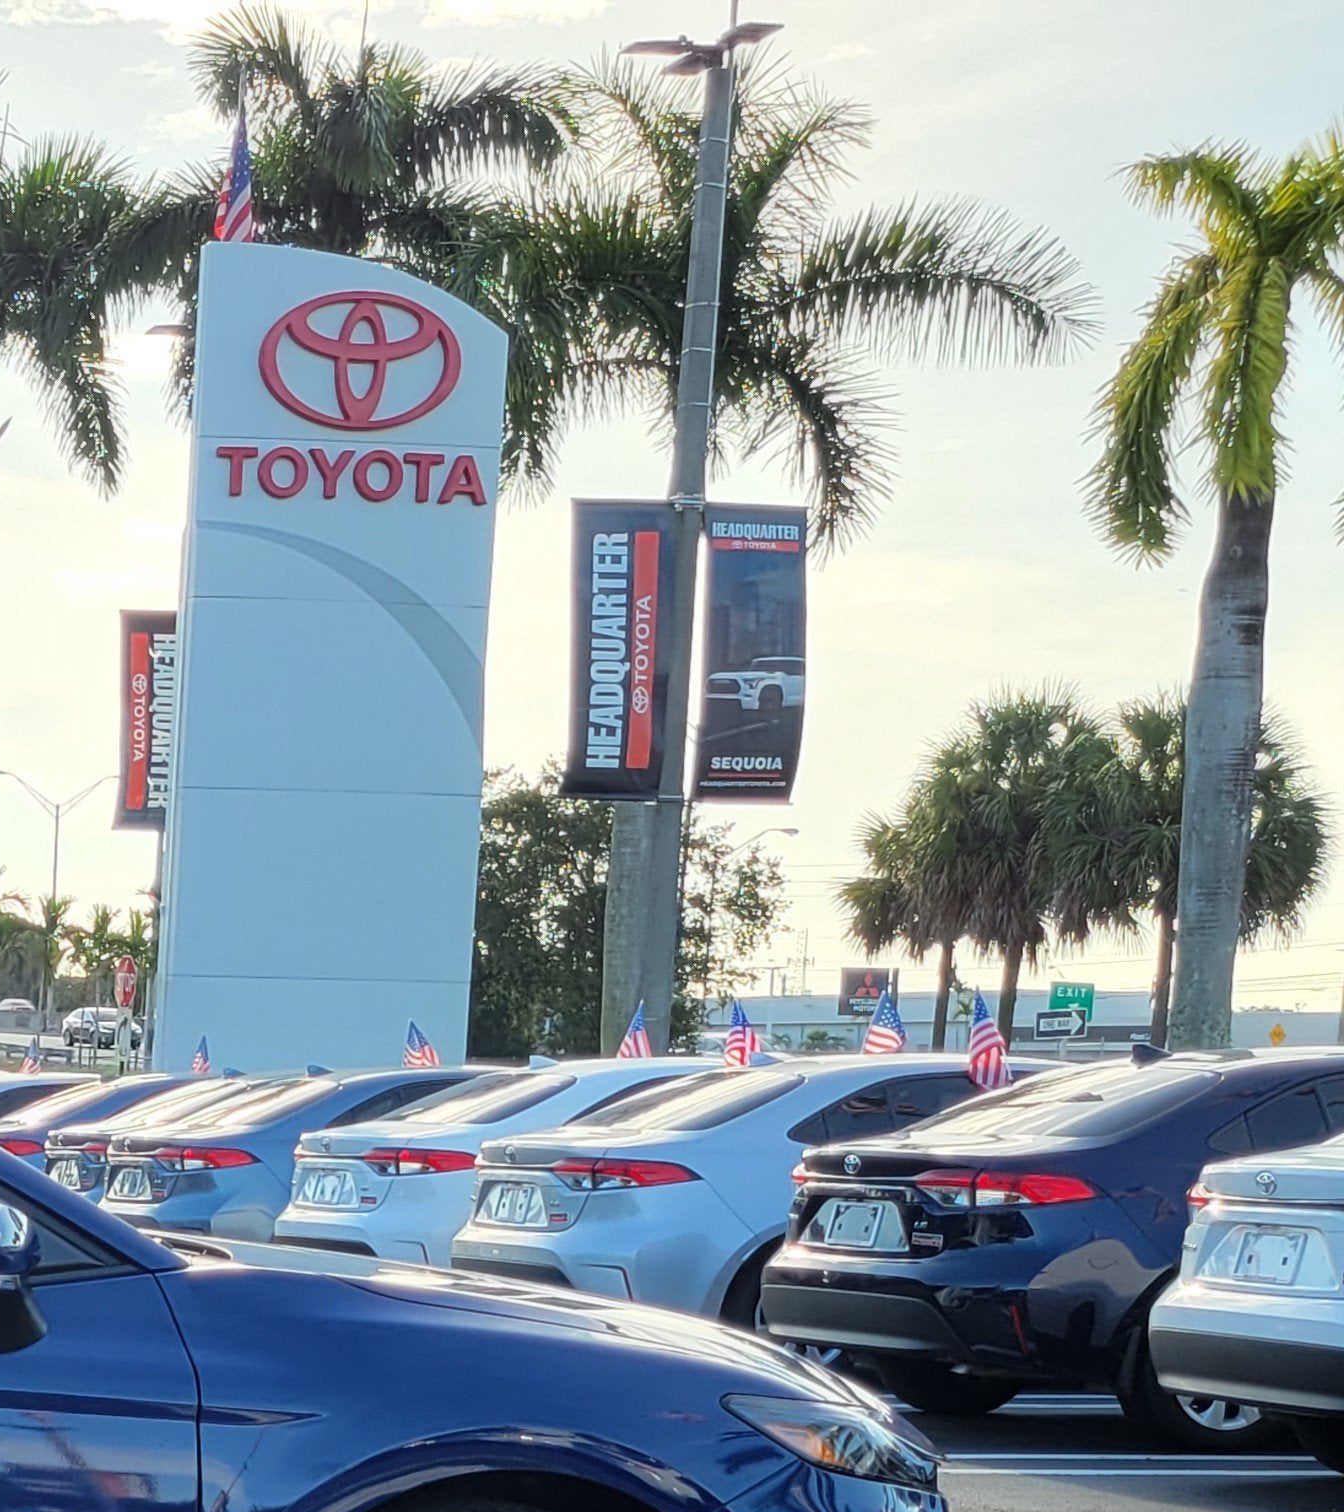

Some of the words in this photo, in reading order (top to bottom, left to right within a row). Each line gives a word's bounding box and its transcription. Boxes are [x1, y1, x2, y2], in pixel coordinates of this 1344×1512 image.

[216, 446, 487, 506] TOYOTA
[712, 521, 799, 540] HEADQUARTER
[743, 541, 777, 550] TOYOTA
[585, 532, 630, 768] HEADQUARTER
[635, 595, 652, 684] TOYOTA
[133, 696, 146, 762] TOYOTA
[147, 633, 177, 808] HEADQUARTER
[710, 756, 783, 771] SEQUOIA
[116, 972, 135, 992] STOP
[1056, 987, 1087, 998] EXIT
